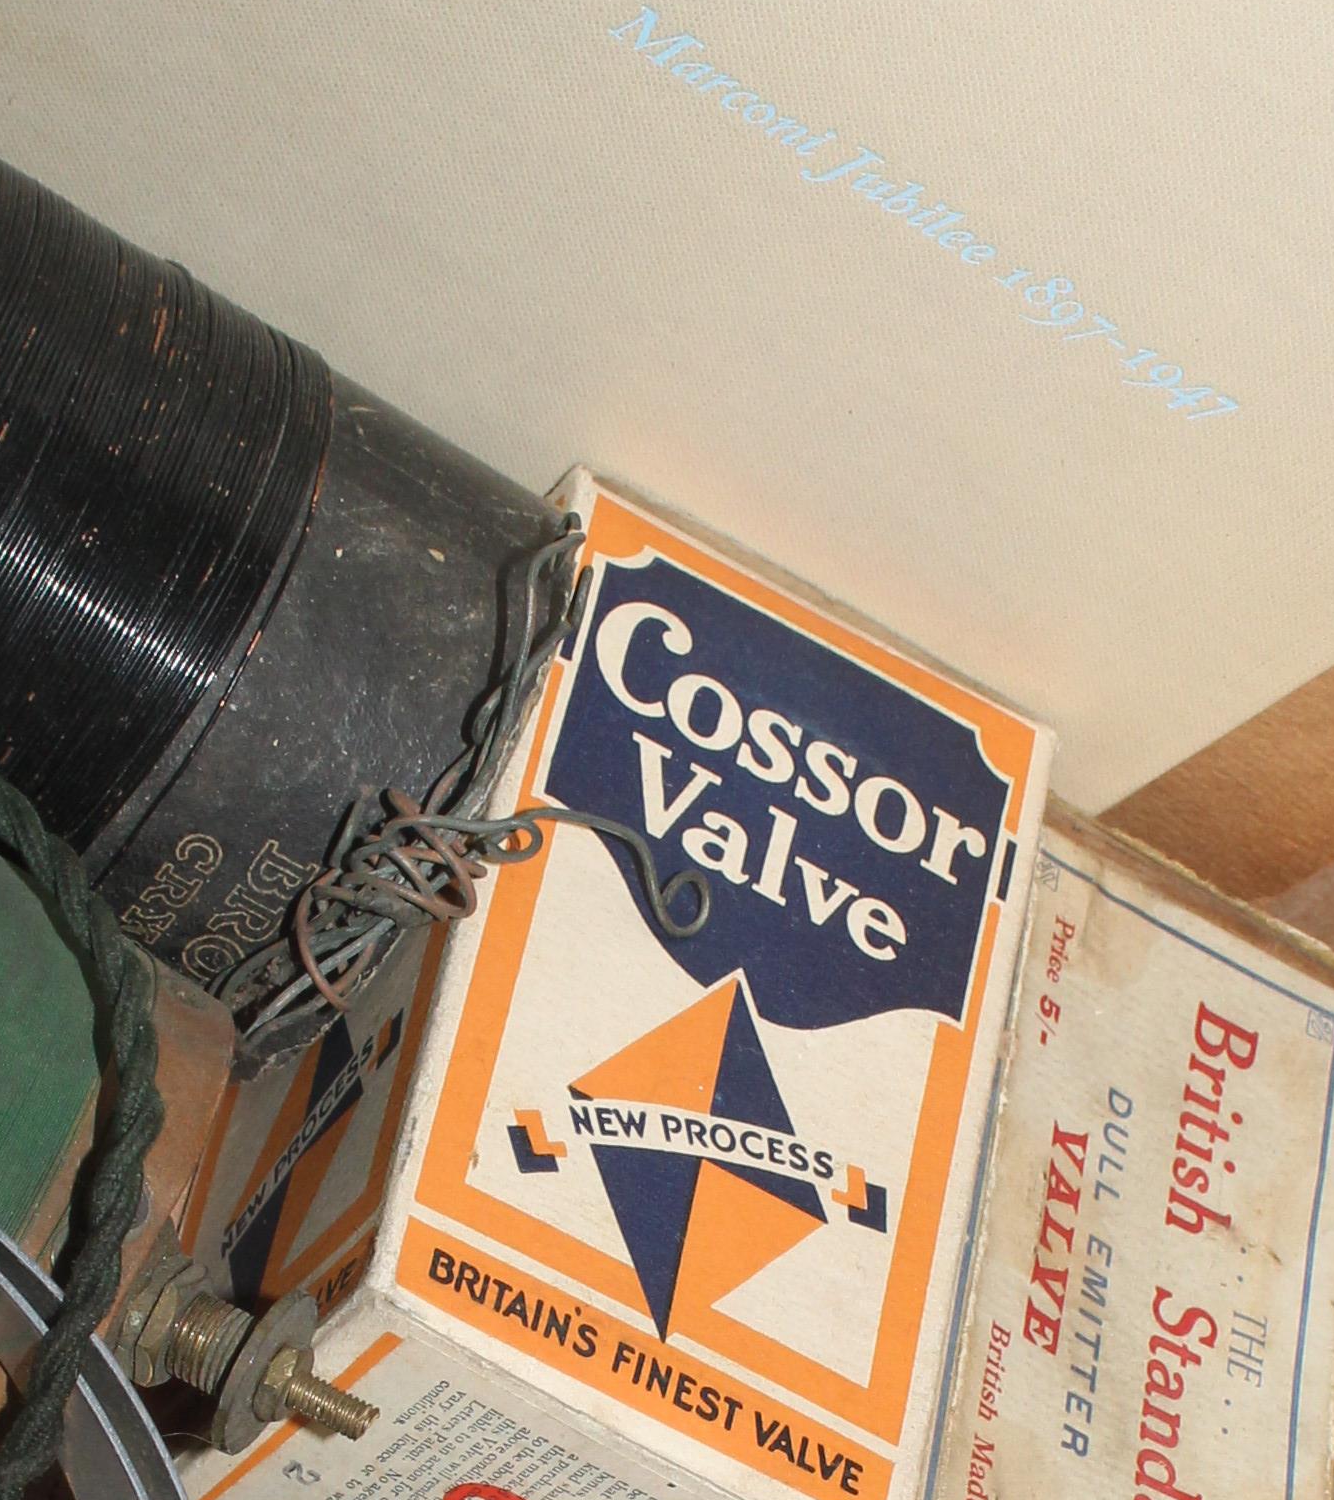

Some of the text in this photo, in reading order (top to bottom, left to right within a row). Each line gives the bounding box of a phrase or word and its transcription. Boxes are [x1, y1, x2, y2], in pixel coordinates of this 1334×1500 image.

[608, 4, 1240, 422] Marconi Jubilee 1897-1947
[596, 601, 987, 884] Cossor
[632, 731, 907, 960] Valve
[119, 833, 224, 943] CRY
[182, 840, 319, 982] BRO
[1035, 915, 1076, 1047] Price 5/-
[1166, 1001, 1260, 1238] British
[220, 1034, 376, 1262] NEW PROCESS
[568, 1105, 835, 1179] NEW PROCESS
[1022, 1120, 1090, 1356] VALVE
[1060, 1085, 1135, 1459] DULL EMITTER
[1225, 1308, 1269, 1389] THE
[428, 1248, 864, 1496] BRITAIN'S FINEST VALVE
[977, 1320, 1013, 1424] British
[392, 1380, 450, 1424] conditions.
[438, 1390, 467, 1412] vary
[413, 1414, 439, 1432] this
[441, 1399, 486, 1431] Letters
[467, 1407, 504, 1432] liable
[490, 1417, 516, 1434] this
[375, 1433, 418, 1462] licence
[401, 1431, 447, 1461] Patent.
[438, 1442, 456, 1455] an
[454, 1432, 471, 1443] to
[458, 1437, 497, 1461] Valve
[495, 1426, 530, 1453] above
[406, 1454, 440, 1481] action
[536, 1444, 565, 1464] that
[345, 1478, 362, 1489] to
[360, 1464, 375, 1476] or
[378, 1468, 402, 1483] No
[437, 1461, 461, 1480] will
[567, 1462, 600, 1484] kind
[390, 1480, 413, 1497] for
[570, 1471, 616, 1497] bonus,
[599, 1479, 629, 1499] that
[626, 1488, 647, 1499] be
